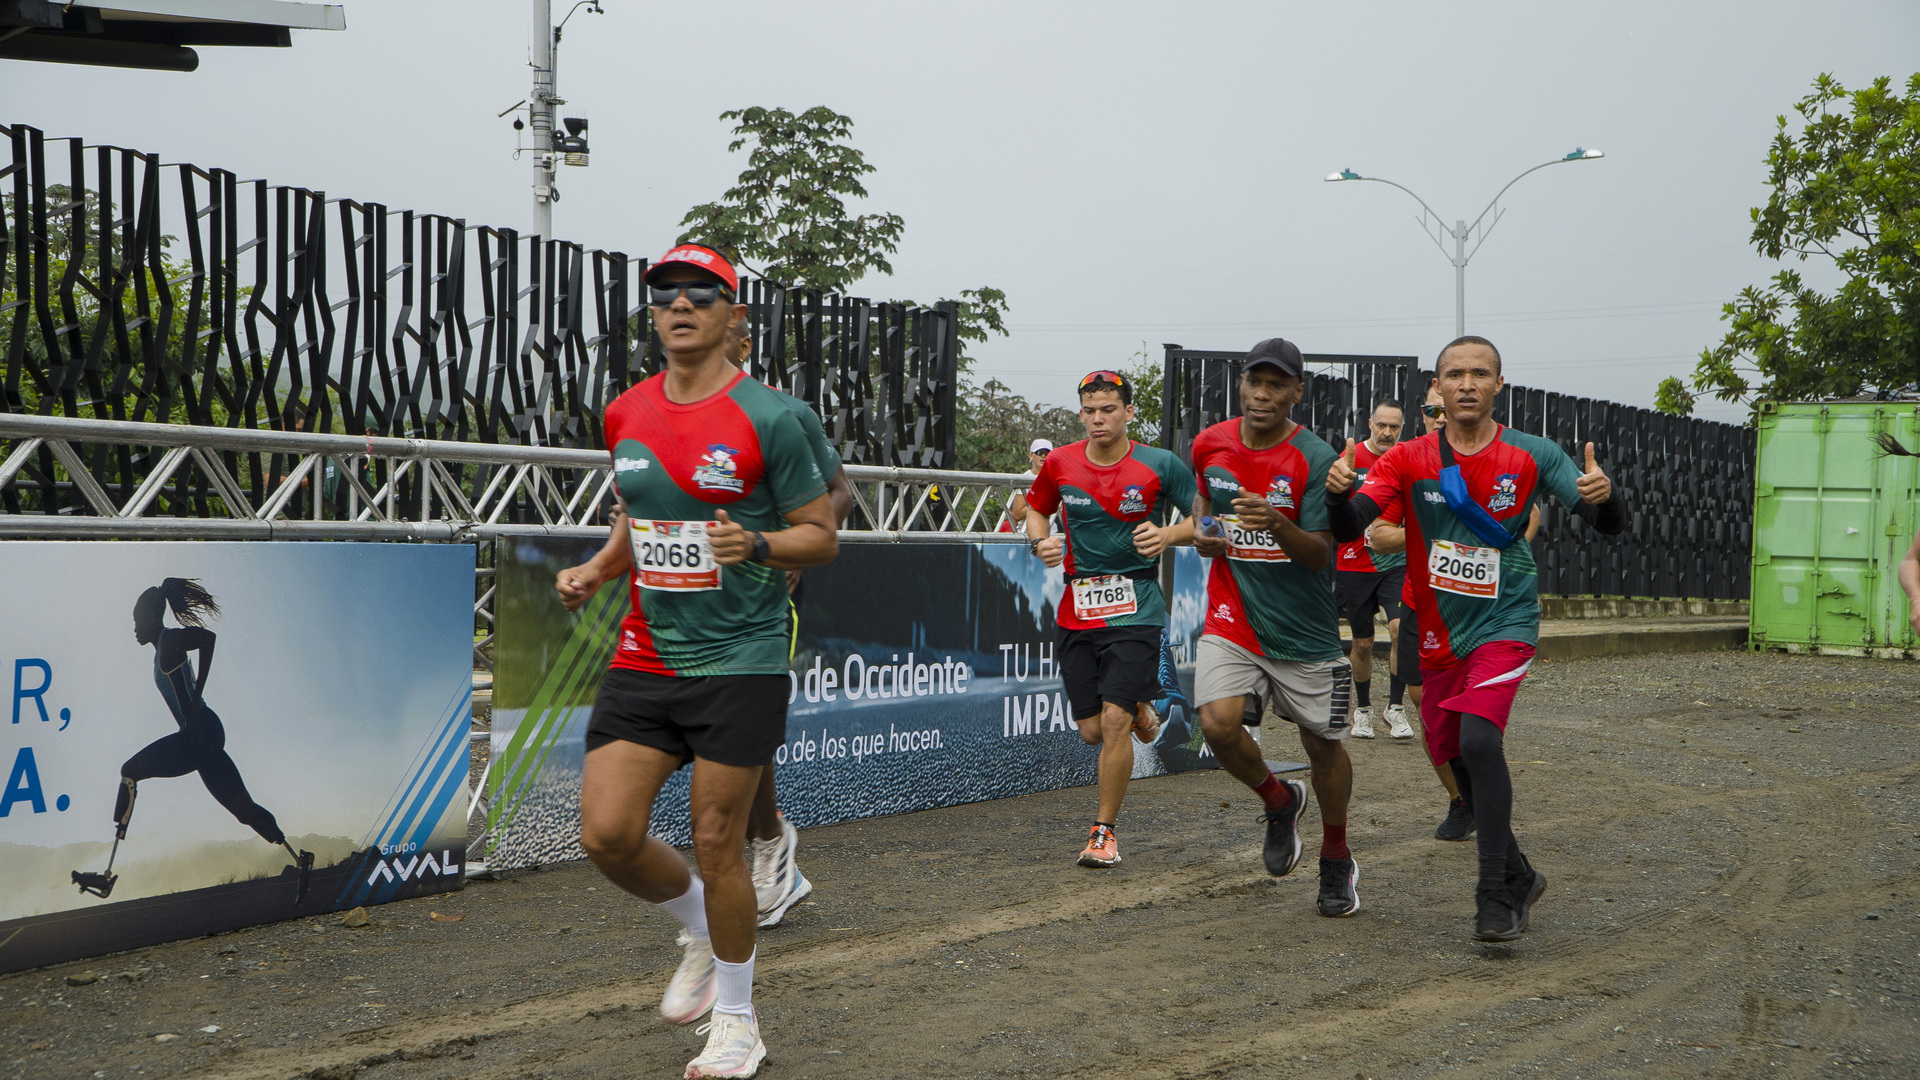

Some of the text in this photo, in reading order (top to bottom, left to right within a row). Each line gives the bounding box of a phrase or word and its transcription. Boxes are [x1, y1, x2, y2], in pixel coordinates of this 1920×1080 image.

[1233, 529, 1275, 547] 2065
[642, 541, 700, 567] 2068
[1437, 556, 1486, 580] 2066
[1085, 586, 1124, 605] 1768
[999, 643, 1029, 683] TU
[804, 656, 838, 703] de
[844, 652, 967, 701] Occidente
[793, 730, 816, 762] de
[821, 728, 847, 760] los
[852, 733, 884, 764] que
[889, 723, 944, 753] hacen.
[381, 841, 417, 855] Grupo
[367, 849, 459, 887] AVAL
